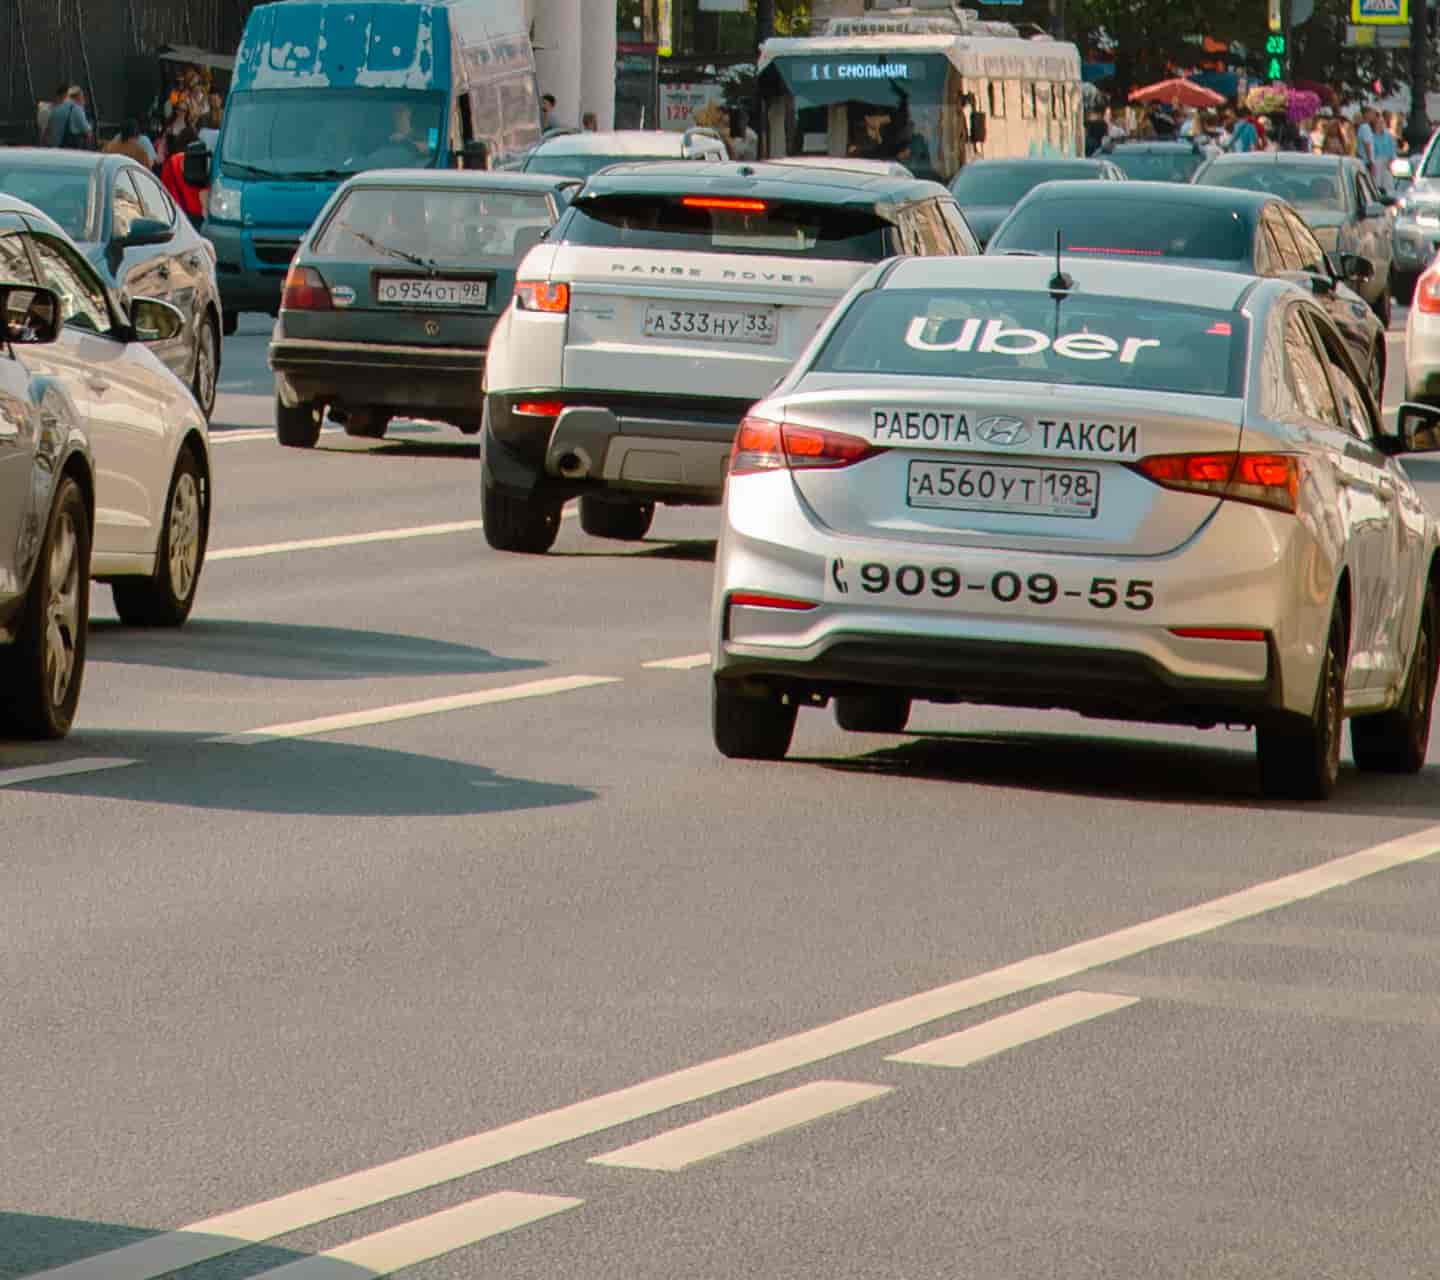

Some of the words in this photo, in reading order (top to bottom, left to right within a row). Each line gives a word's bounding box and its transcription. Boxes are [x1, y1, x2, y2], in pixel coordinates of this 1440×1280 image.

[611, 263, 703, 277] RANGE
[721, 269, 816, 284] ROVER
[653, 307, 739, 334] А333НУ
[745, 313, 767, 331] 33
[904, 316, 1161, 364] Uber
[872, 410, 971, 443] РАБОТА
[1038, 420, 1138, 454] ТАКСИ
[917, 467, 1035, 502] А560УТ
[1043, 473, 1088, 497] 198
[860, 562, 1155, 611] 909-09-55
